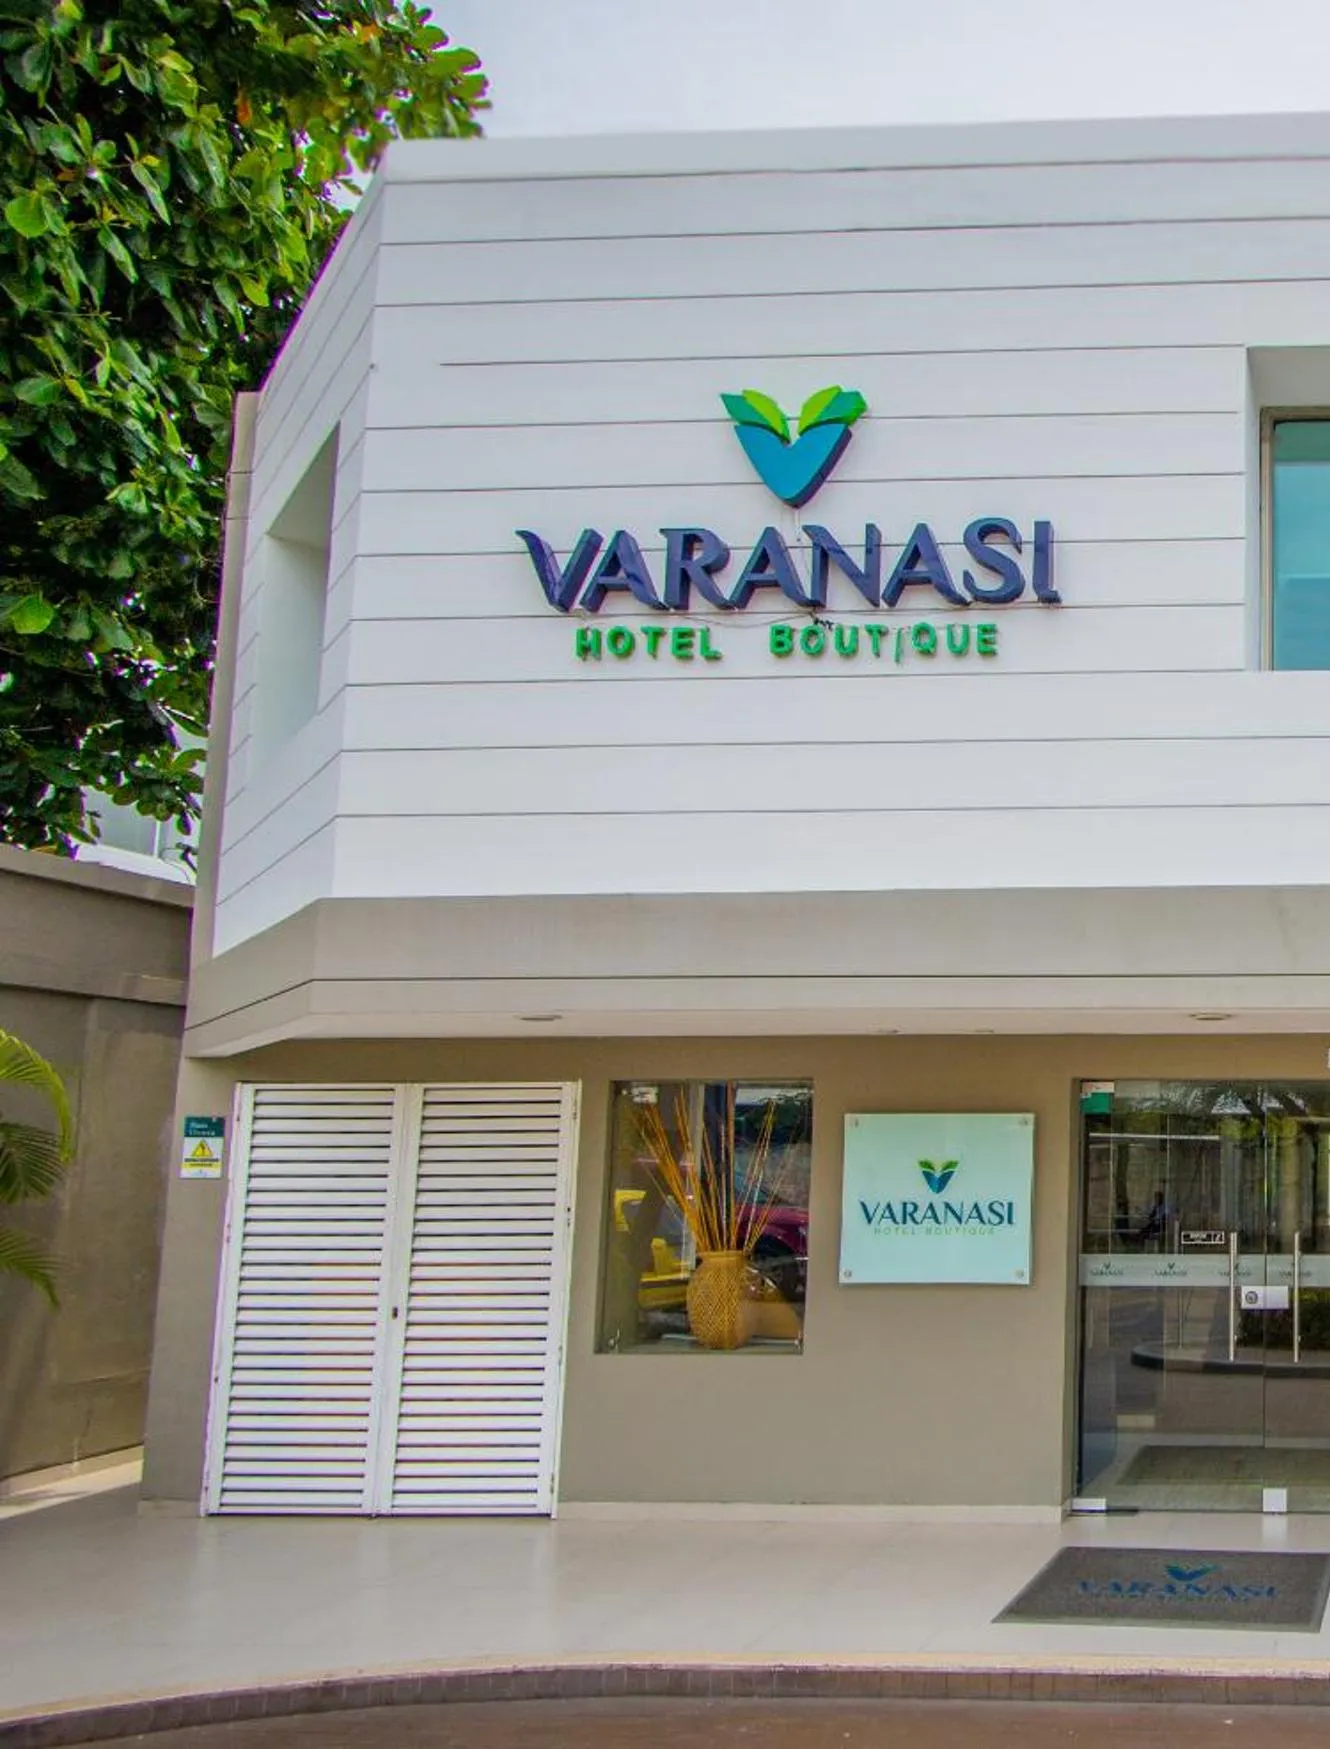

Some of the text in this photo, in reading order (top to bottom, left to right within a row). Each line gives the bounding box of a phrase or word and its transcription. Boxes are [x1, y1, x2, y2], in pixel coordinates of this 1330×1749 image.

[515, 517, 1062, 613] VARANASI
[574, 621, 999, 663] HOTEL BOUTIQUE
[859, 1200, 1015, 1226] VARANASI
